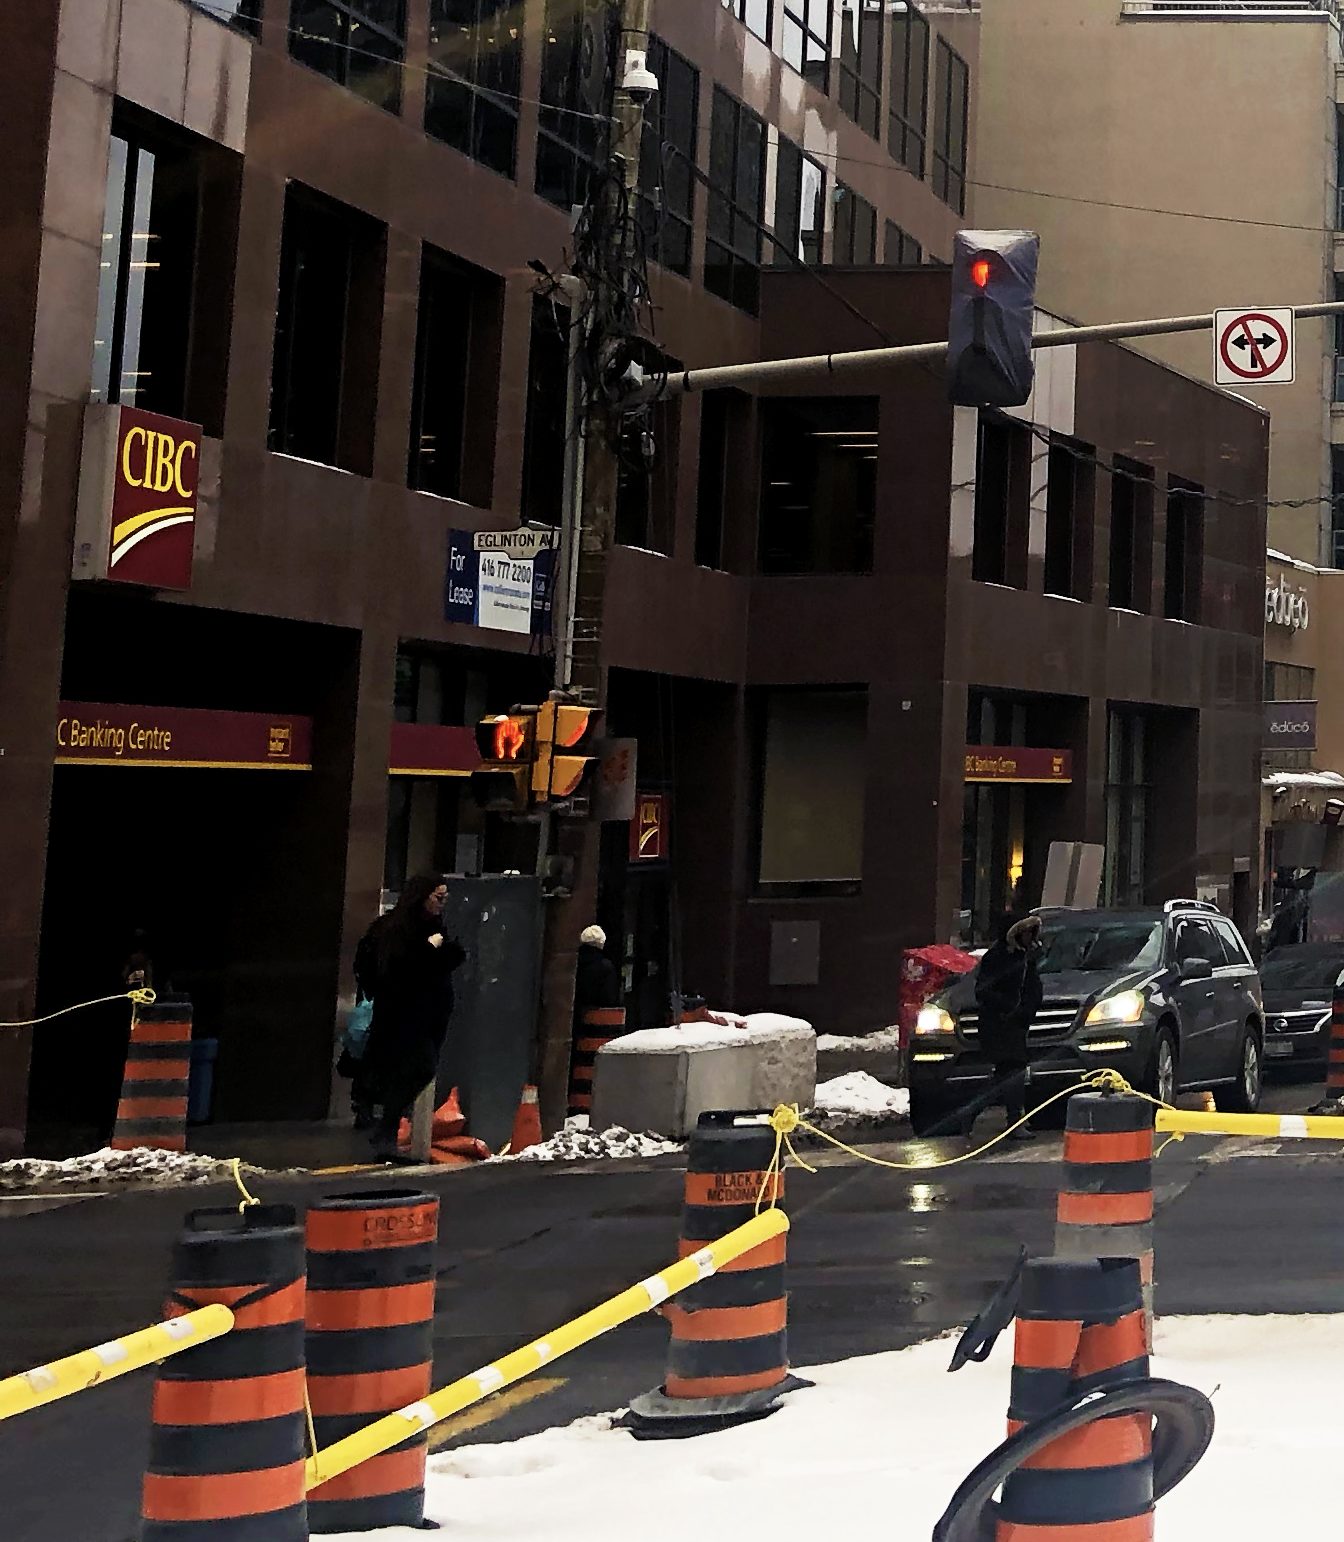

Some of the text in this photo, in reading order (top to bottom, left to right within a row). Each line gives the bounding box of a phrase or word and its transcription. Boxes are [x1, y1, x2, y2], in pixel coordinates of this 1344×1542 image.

[122, 426, 197, 498] CIBC
[477, 533, 535, 548] EGLINTON
[450, 546, 466, 571] For
[482, 558, 532, 584] 416 777 2200
[448, 580, 474, 605] Lease
[71, 719, 124, 755] Banking
[129, 723, 172, 750] Centre
[715, 1173, 752, 1187] BLACK
[707, 1185, 770, 1202] MCDONAD
